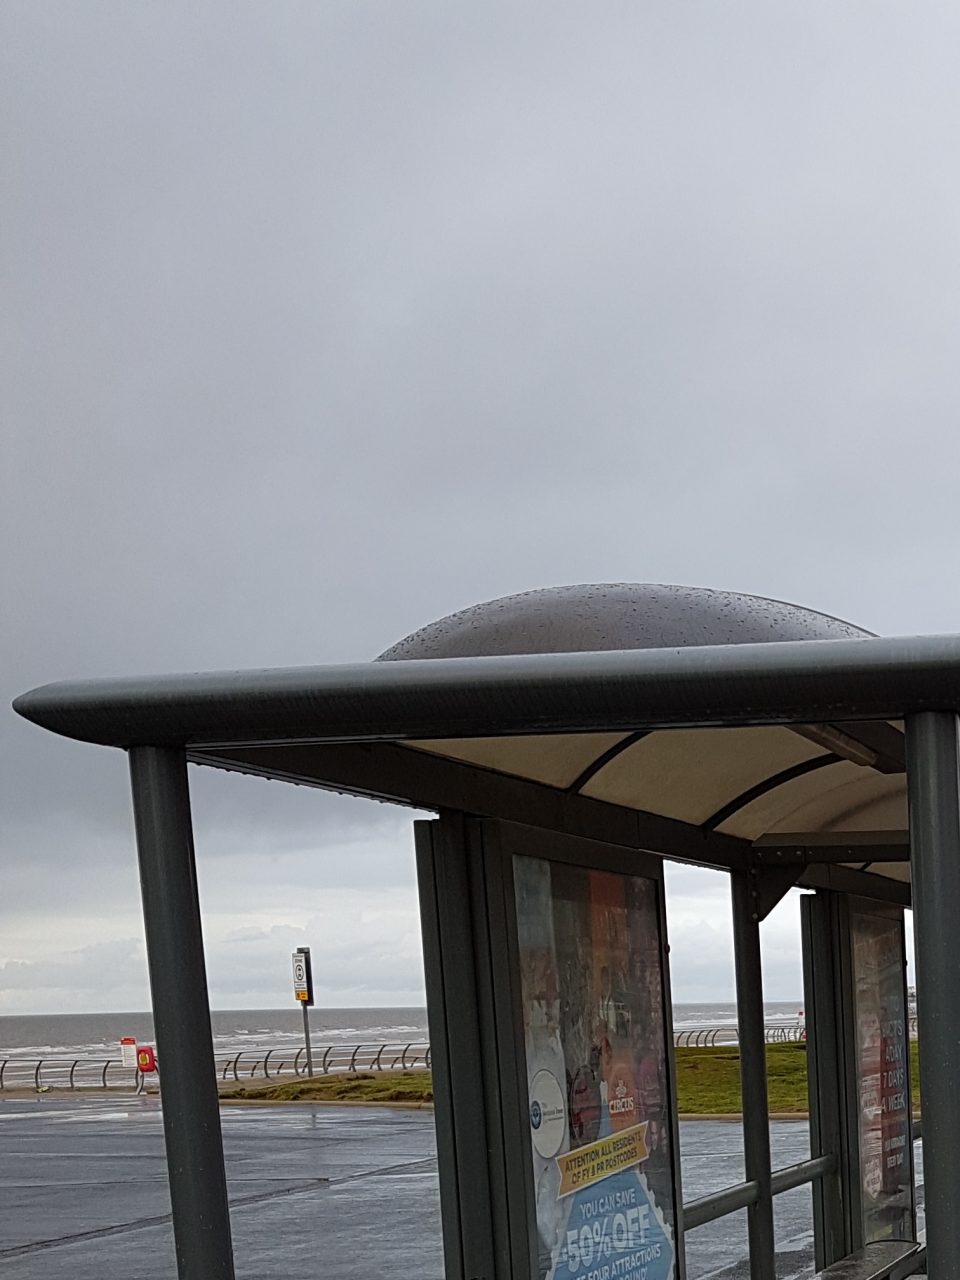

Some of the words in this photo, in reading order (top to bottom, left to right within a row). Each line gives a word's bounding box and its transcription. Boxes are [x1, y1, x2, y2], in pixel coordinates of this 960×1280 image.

[890, 1044, 903, 1062] DAY
[888, 1069, 904, 1088] DAYS
[609, 1097, 634, 1114] CIRCUS
[888, 1092, 905, 1112] WEEK
[565, 1150, 600, 1173] ATTENTION
[600, 1144, 612, 1159] ALL
[612, 1131, 641, 1154] RESIDENTS
[571, 1171, 581, 1184] OF
[581, 1167, 590, 1181] FY
[596, 1160, 604, 1174] PR
[605, 1147, 638, 1170] POSTCODES
[580, 1203, 598, 1220] YOU
[599, 1196, 616, 1213] CAN
[616, 1188, 635, 1207] SAVE
[613, 1204, 650, 1253] OFF
[611, 1243, 661, 1276] ATTRACTIONS
